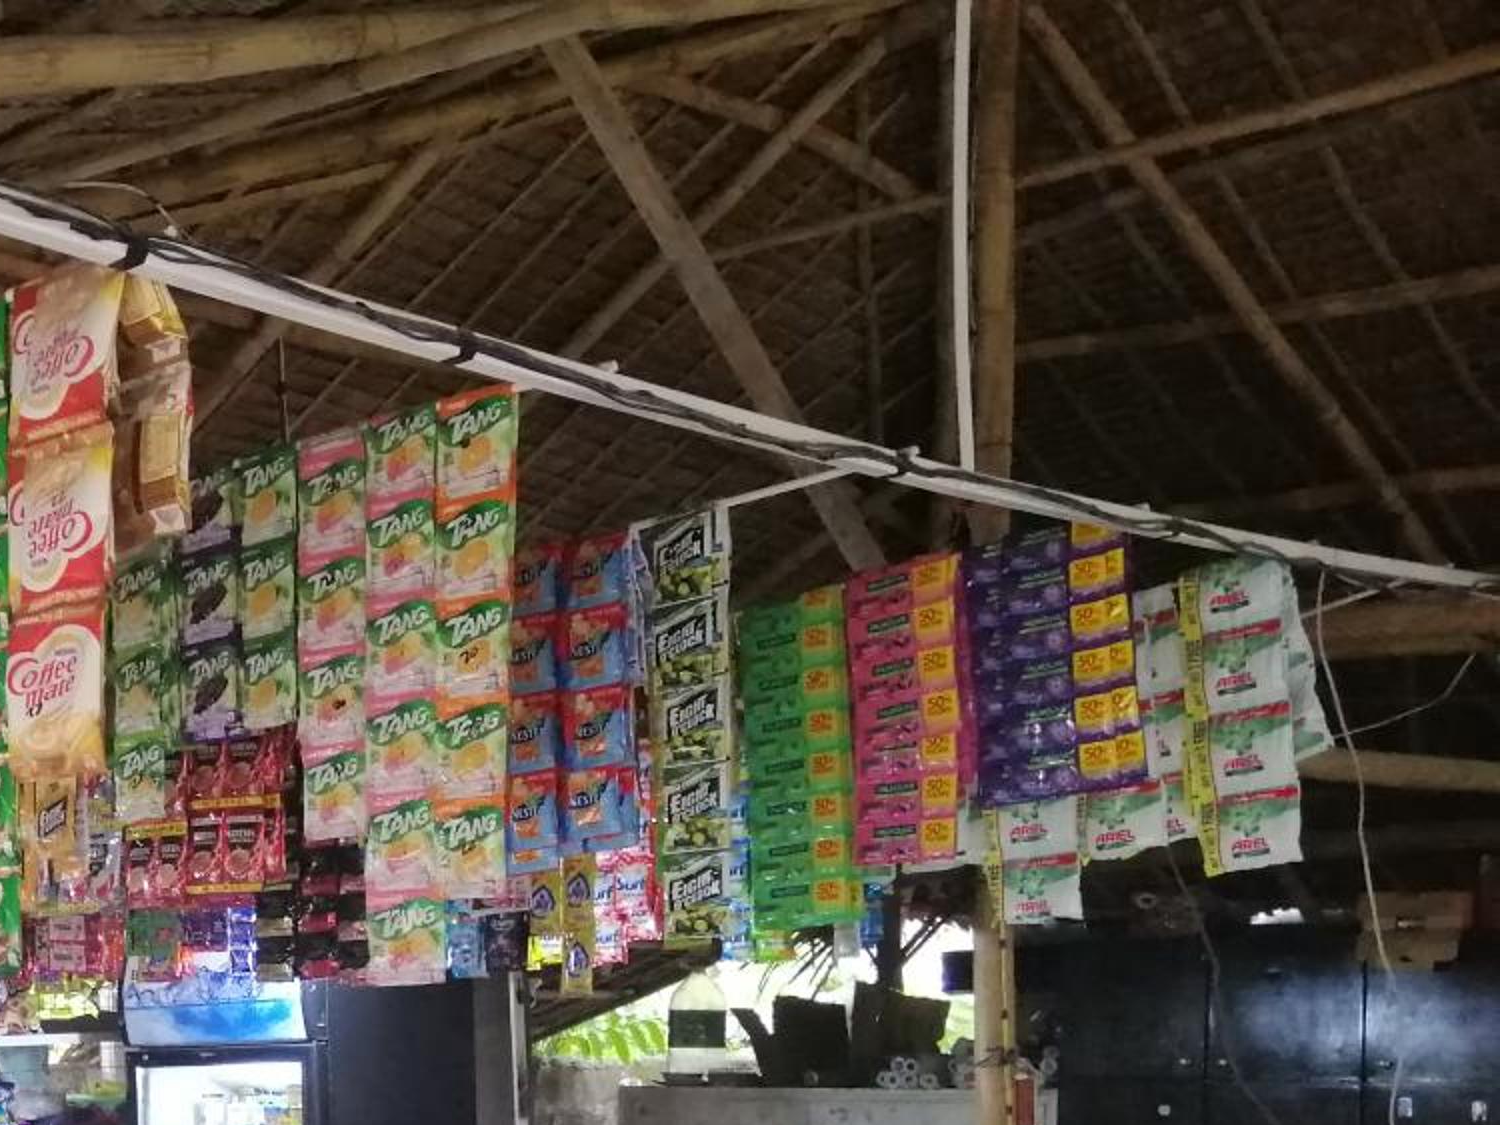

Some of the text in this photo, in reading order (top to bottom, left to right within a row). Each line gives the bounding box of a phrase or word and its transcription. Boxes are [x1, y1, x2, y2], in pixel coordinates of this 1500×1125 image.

[372, 506, 426, 547] TANG
[374, 606, 430, 647] TANG
[445, 607, 501, 648] TANG
[308, 661, 358, 698] TANG
[373, 706, 429, 746] TANG
[373, 806, 431, 844] TANG
[442, 813, 497, 851] TANG
